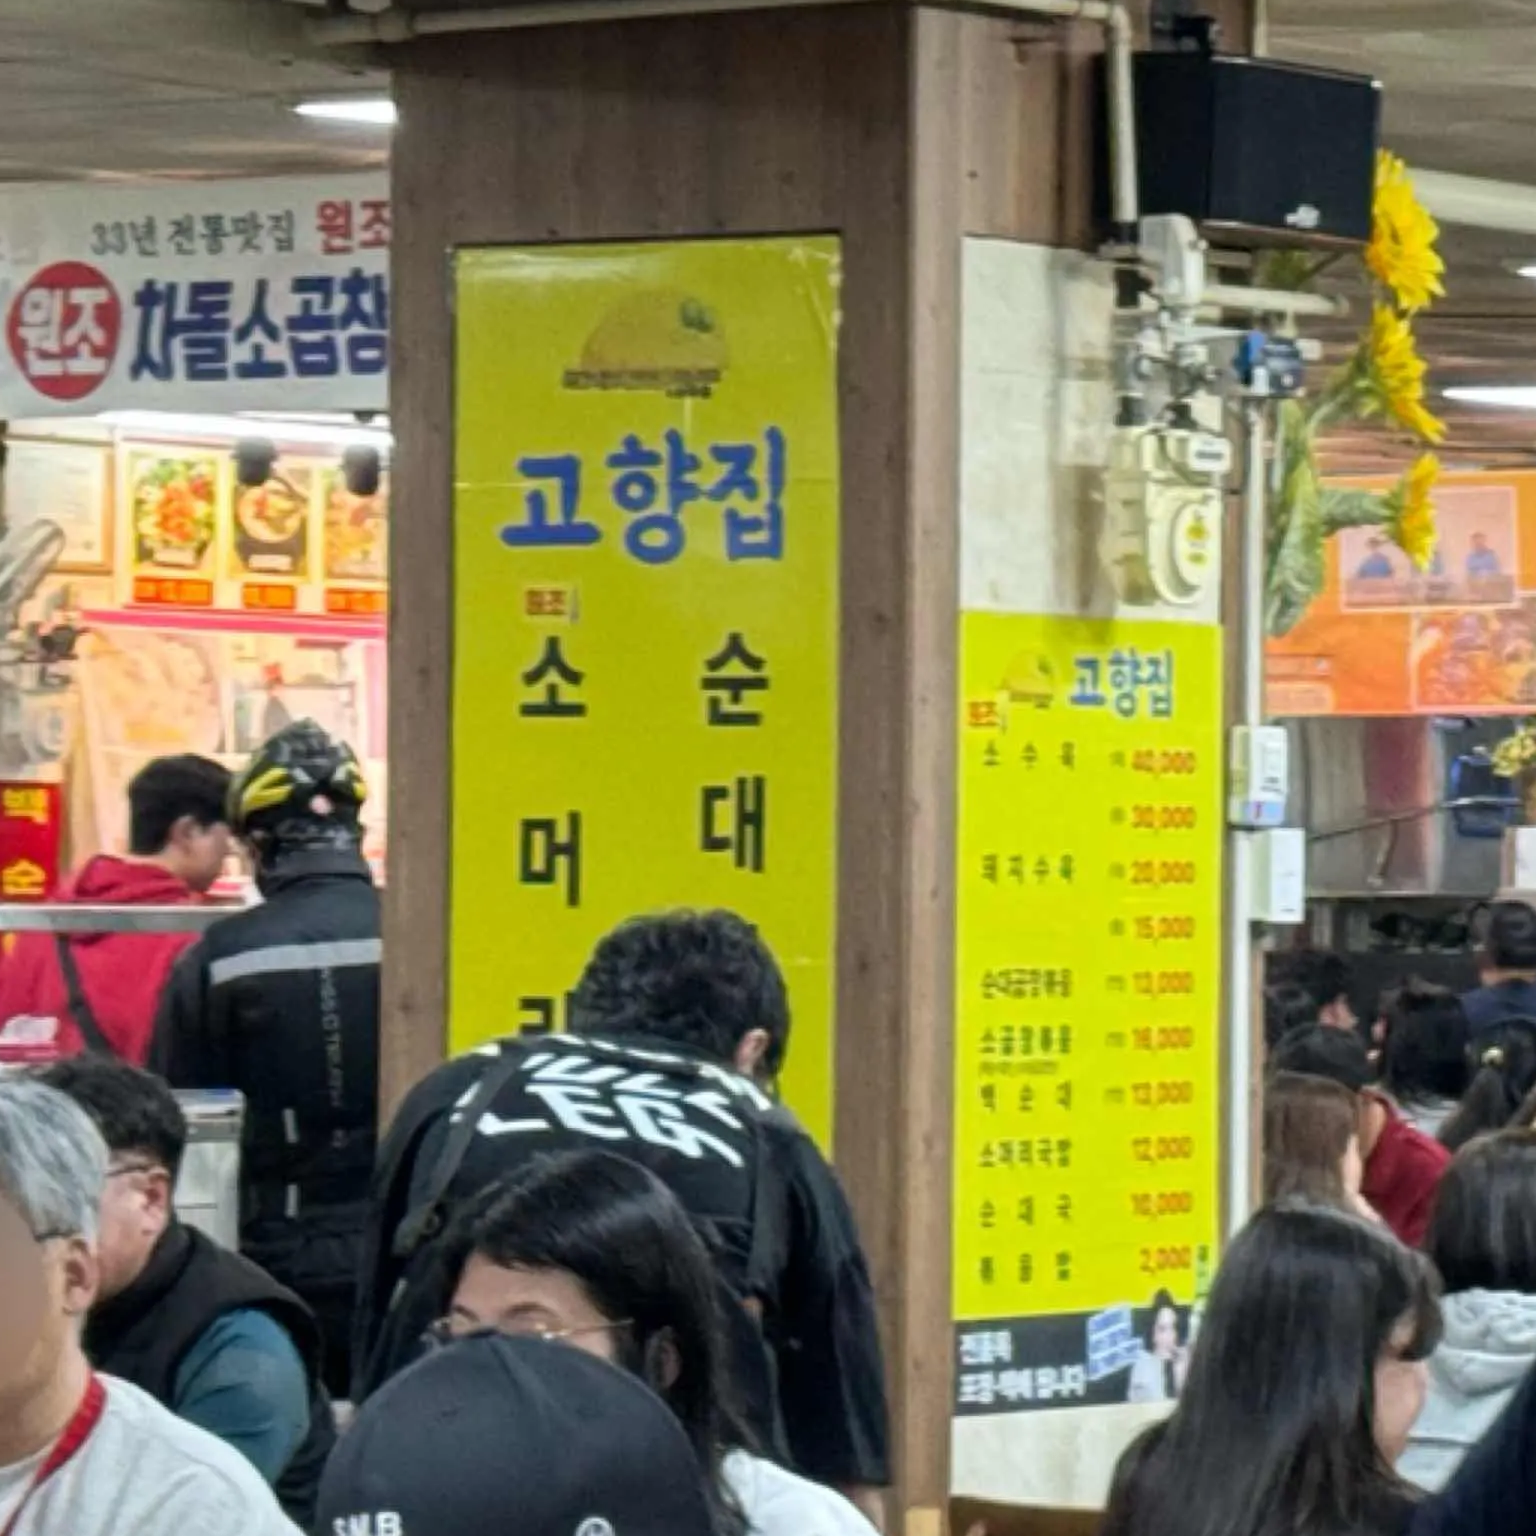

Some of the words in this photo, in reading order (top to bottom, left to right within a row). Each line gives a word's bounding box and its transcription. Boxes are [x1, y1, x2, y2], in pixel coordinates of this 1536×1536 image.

[91, 219, 161, 258] 33년
[167, 209, 296, 256] 전통맛집
[17, 286, 110, 376] 원조
[131, 267, 389, 383] 차돌소곱창
[499, 426, 788, 563] 고향집
[1069, 647, 1173, 718] 고향집
[699, 633, 770, 871] 순대
